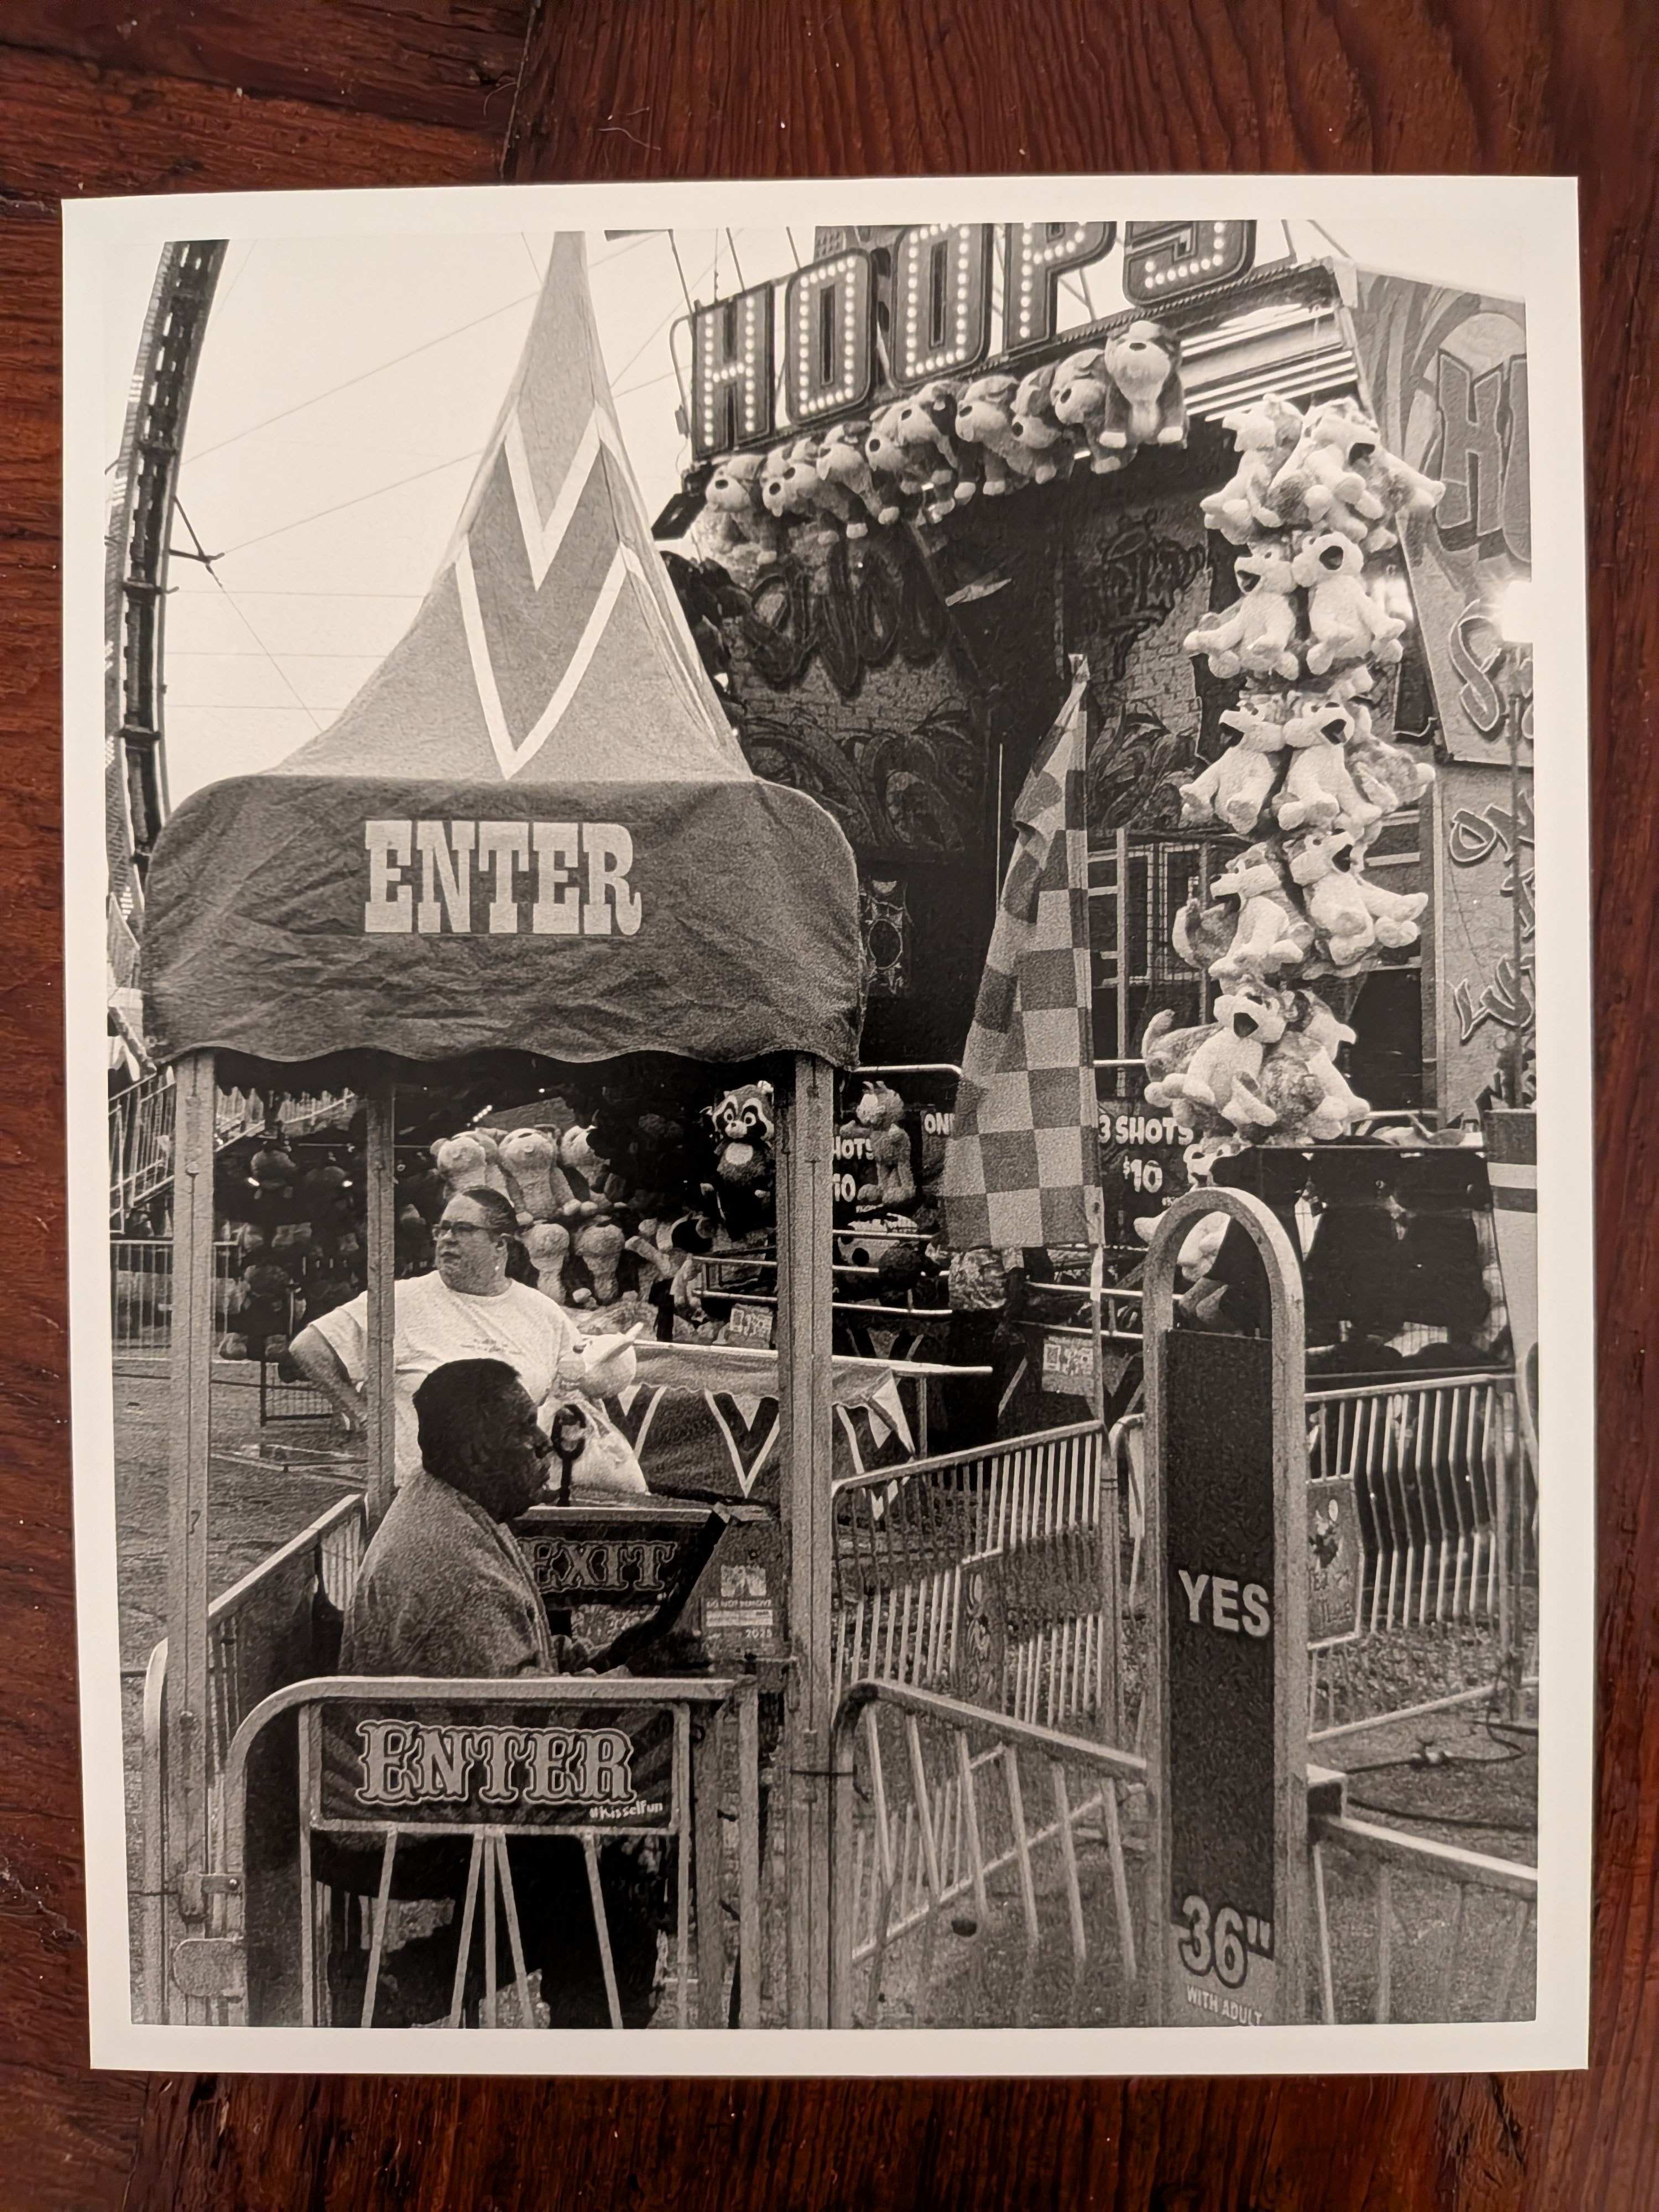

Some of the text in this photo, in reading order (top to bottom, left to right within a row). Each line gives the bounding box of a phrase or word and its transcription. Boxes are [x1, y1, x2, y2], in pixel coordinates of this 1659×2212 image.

[691, 220, 1258, 460] HOOPS
[365, 820, 642, 936] ENTER
[1098, 1114, 1193, 1145] 3 SHOTS
[1123, 1156, 1162, 1193] $10
[517, 1536, 678, 1594] EXIT
[1178, 1569, 1270, 1637] YES
[356, 1719, 637, 1806] ENTER
[1178, 1894, 1272, 1989] 36"
[1187, 1986, 1262, 2026] WITH ADULT
